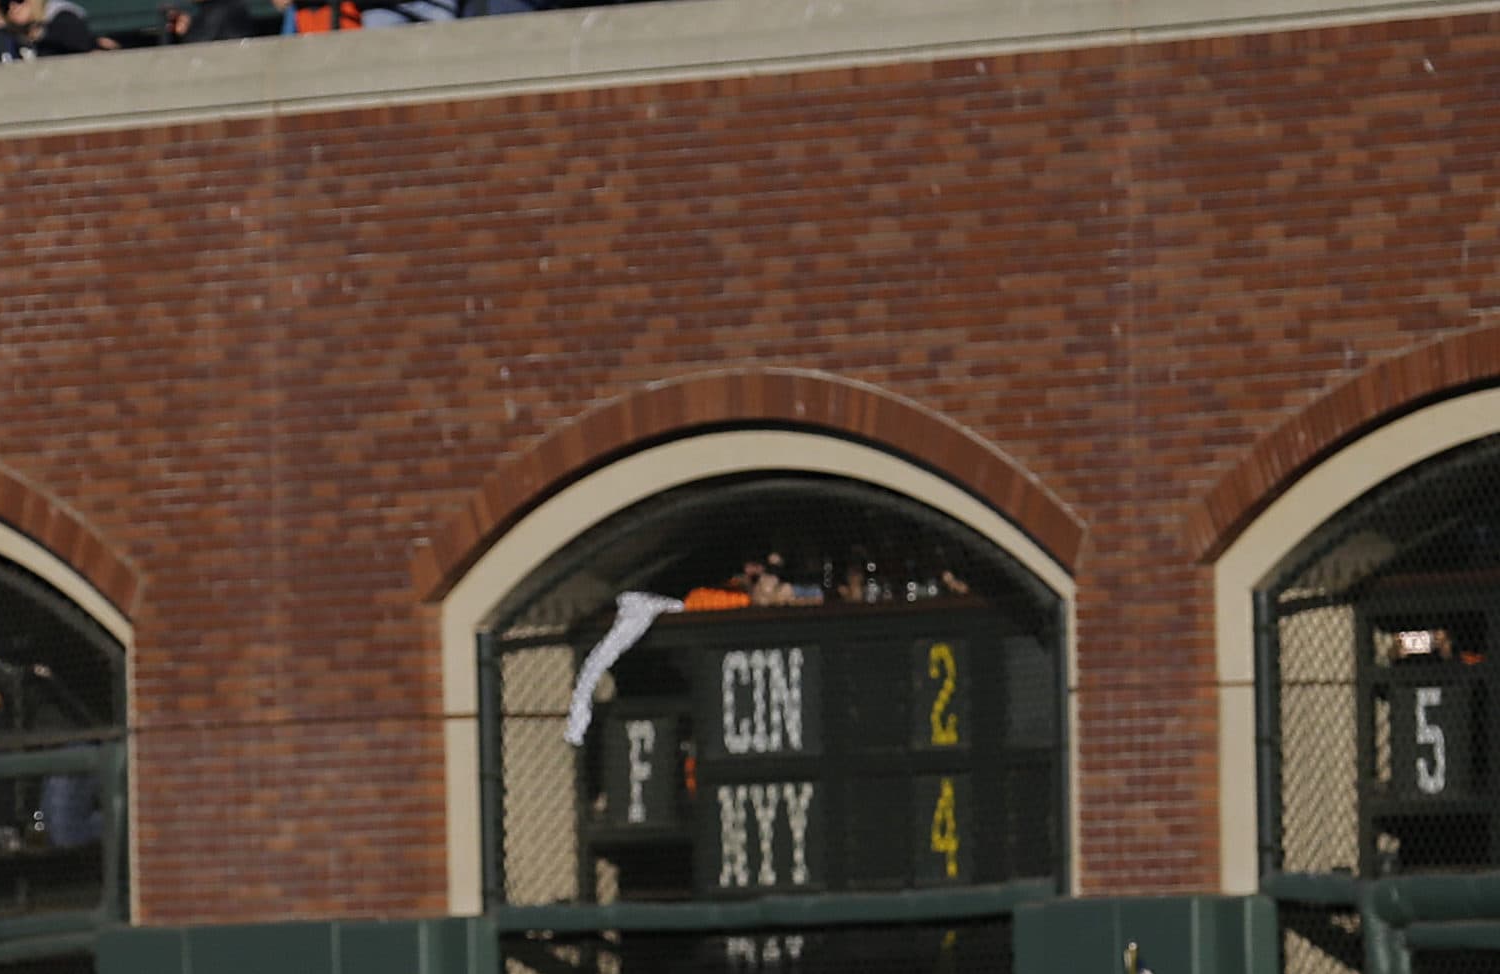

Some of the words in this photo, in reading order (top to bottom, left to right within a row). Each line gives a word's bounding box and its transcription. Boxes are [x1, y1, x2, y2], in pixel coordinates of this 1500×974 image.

[722, 648, 803, 754] CIN
[929, 643, 958, 746] 2
[1415, 687, 1446, 794] 5
[625, 720, 656, 823] F
[718, 782, 813, 887] NYY
[930, 777, 959, 878] 4
